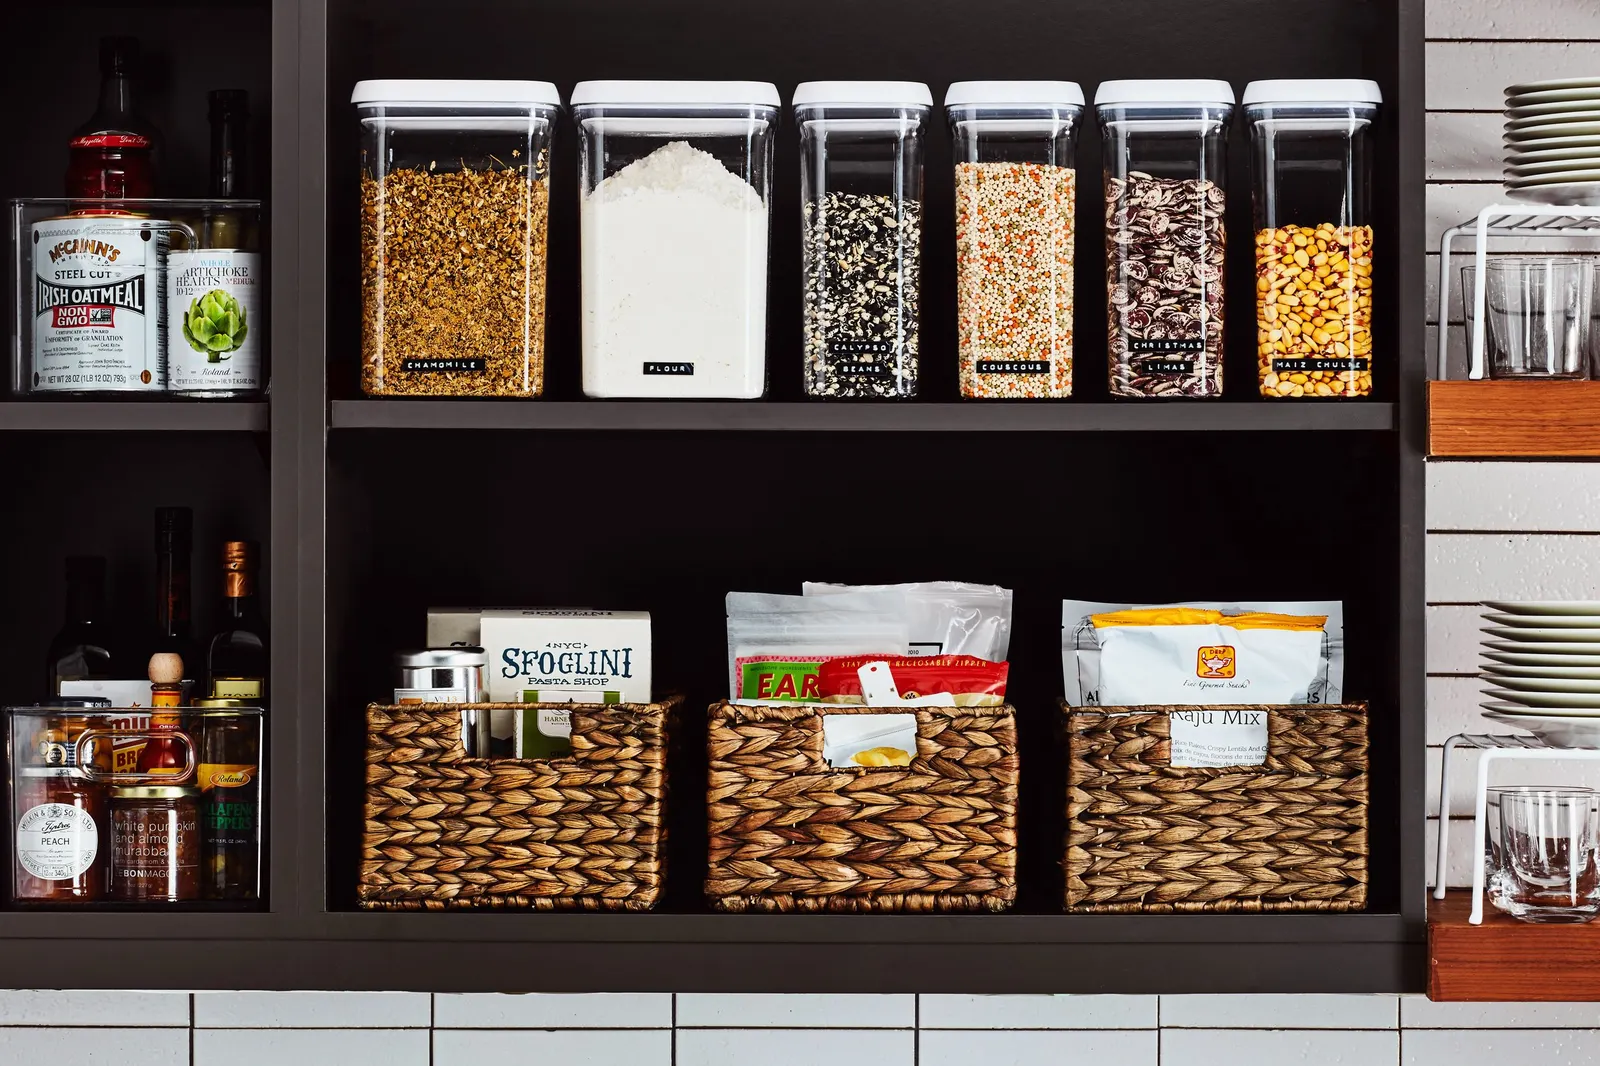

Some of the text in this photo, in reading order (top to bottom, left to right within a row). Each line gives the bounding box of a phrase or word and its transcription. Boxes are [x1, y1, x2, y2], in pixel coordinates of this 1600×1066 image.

[54, 269, 112, 280] STEEL CUT
[182, 267, 249, 277] ARTICHOKE
[176, 277, 221, 286] HEARTS
[39, 278, 143, 310] IRISH OATMEAL
[58, 307, 87, 317] NON
[57, 316, 88, 326] GMO
[407, 361, 476, 369] CHAMOMILE
[842, 365, 880, 373] BEANS
[982, 363, 1042, 371] COUSCOUS
[1148, 363, 1186, 371] LIMAS
[47, 375, 57, 384] NET
[57, 375, 65, 383] WT
[65, 375, 72, 383] 28
[72, 375, 80, 383] OZ
[94, 375, 101, 383] 12
[501, 647, 633, 679] SFOGLINI
[895, 659, 951, 668] RECLOSABLE
[955, 659, 987, 668] ZIPPER
[527, 677, 610, 686] PASTA SHOP
[1222, 710, 1261, 726] Mix
[217, 773, 245, 783] Roland
[21, 811, 39, 830] WILKIN
[40, 809, 46, 817] &
[82, 817, 94, 830] LTD
[115, 820, 144, 831] white
[41, 837, 70, 846] PEACH
[115, 833, 184, 844] and almod
